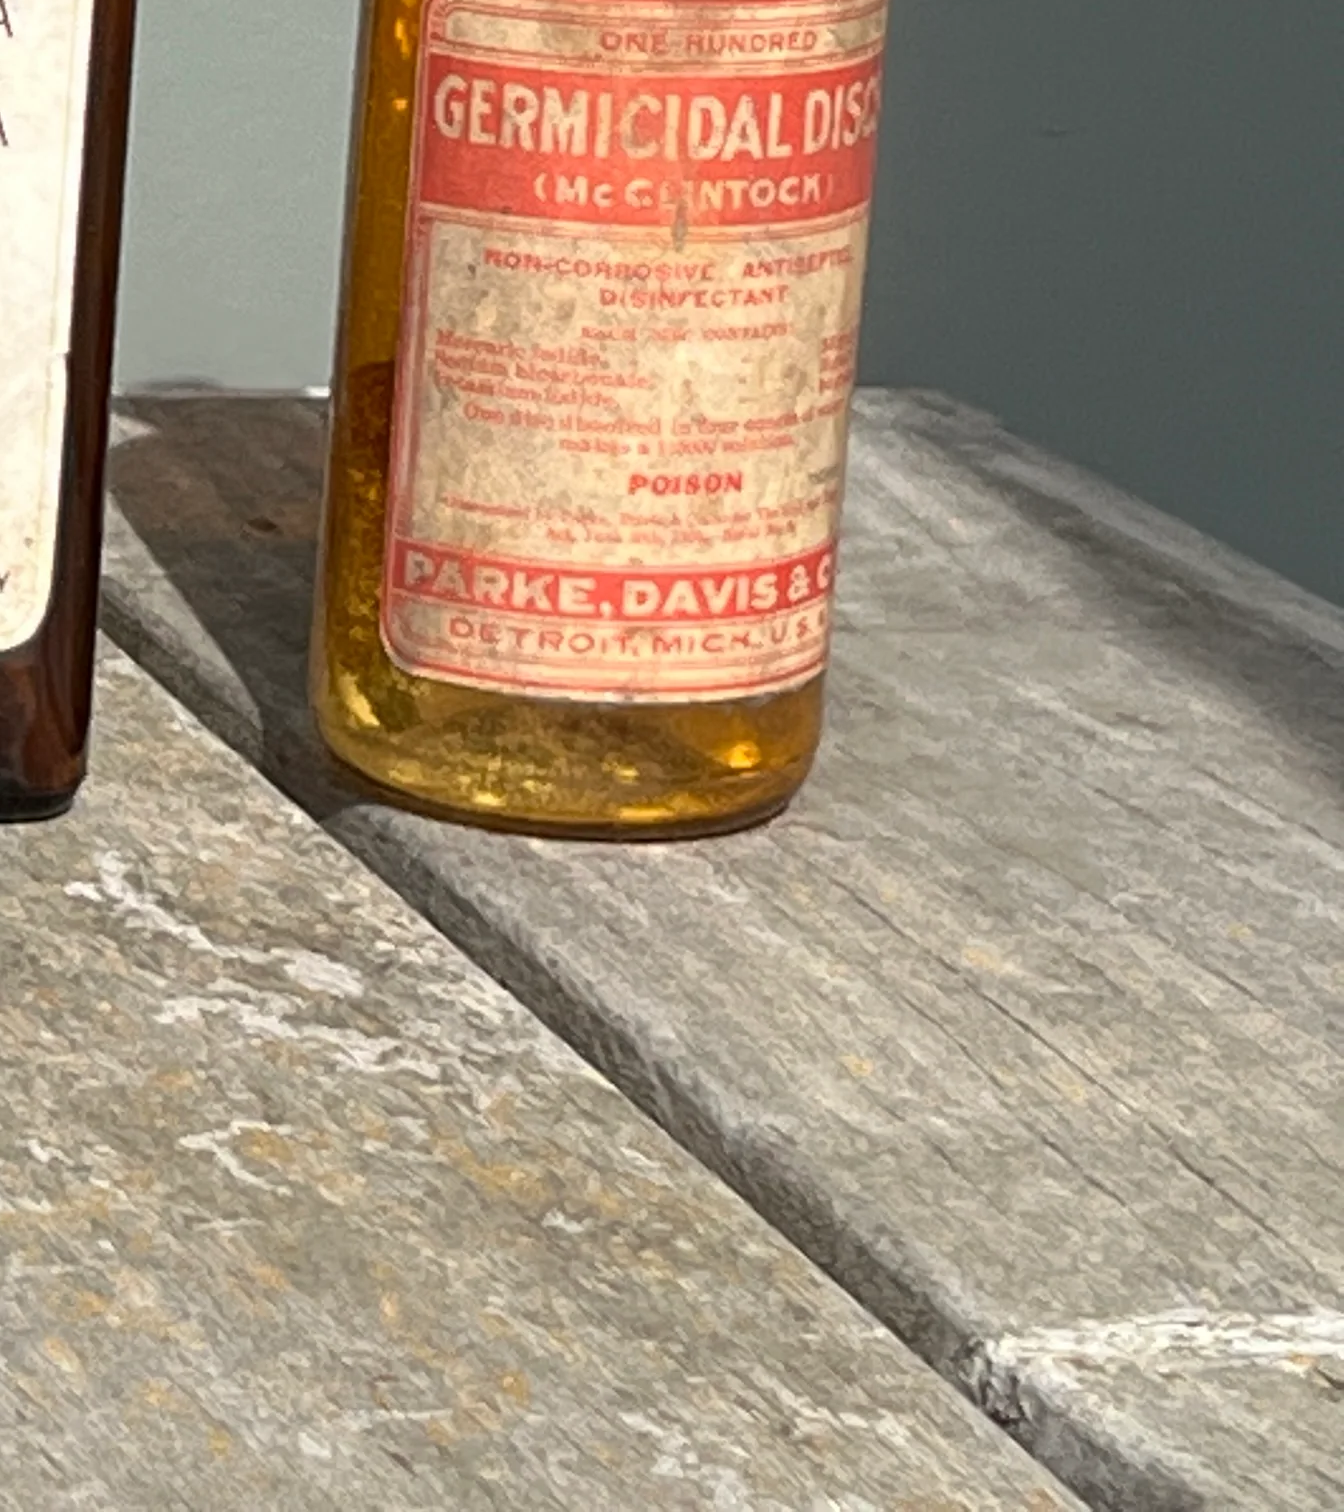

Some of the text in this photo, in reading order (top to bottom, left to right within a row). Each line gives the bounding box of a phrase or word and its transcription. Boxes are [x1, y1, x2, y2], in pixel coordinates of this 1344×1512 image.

[599, 29, 818, 55] ONE HUNDRED
[433, 73, 794, 162] GERMICIDAL
[599, 285, 790, 309] DISINFECTANT
[628, 472, 743, 496] POISON
[403, 550, 613, 618] PARKE,
[622, 572, 778, 618] DAVIS
[786, 564, 810, 602] &
